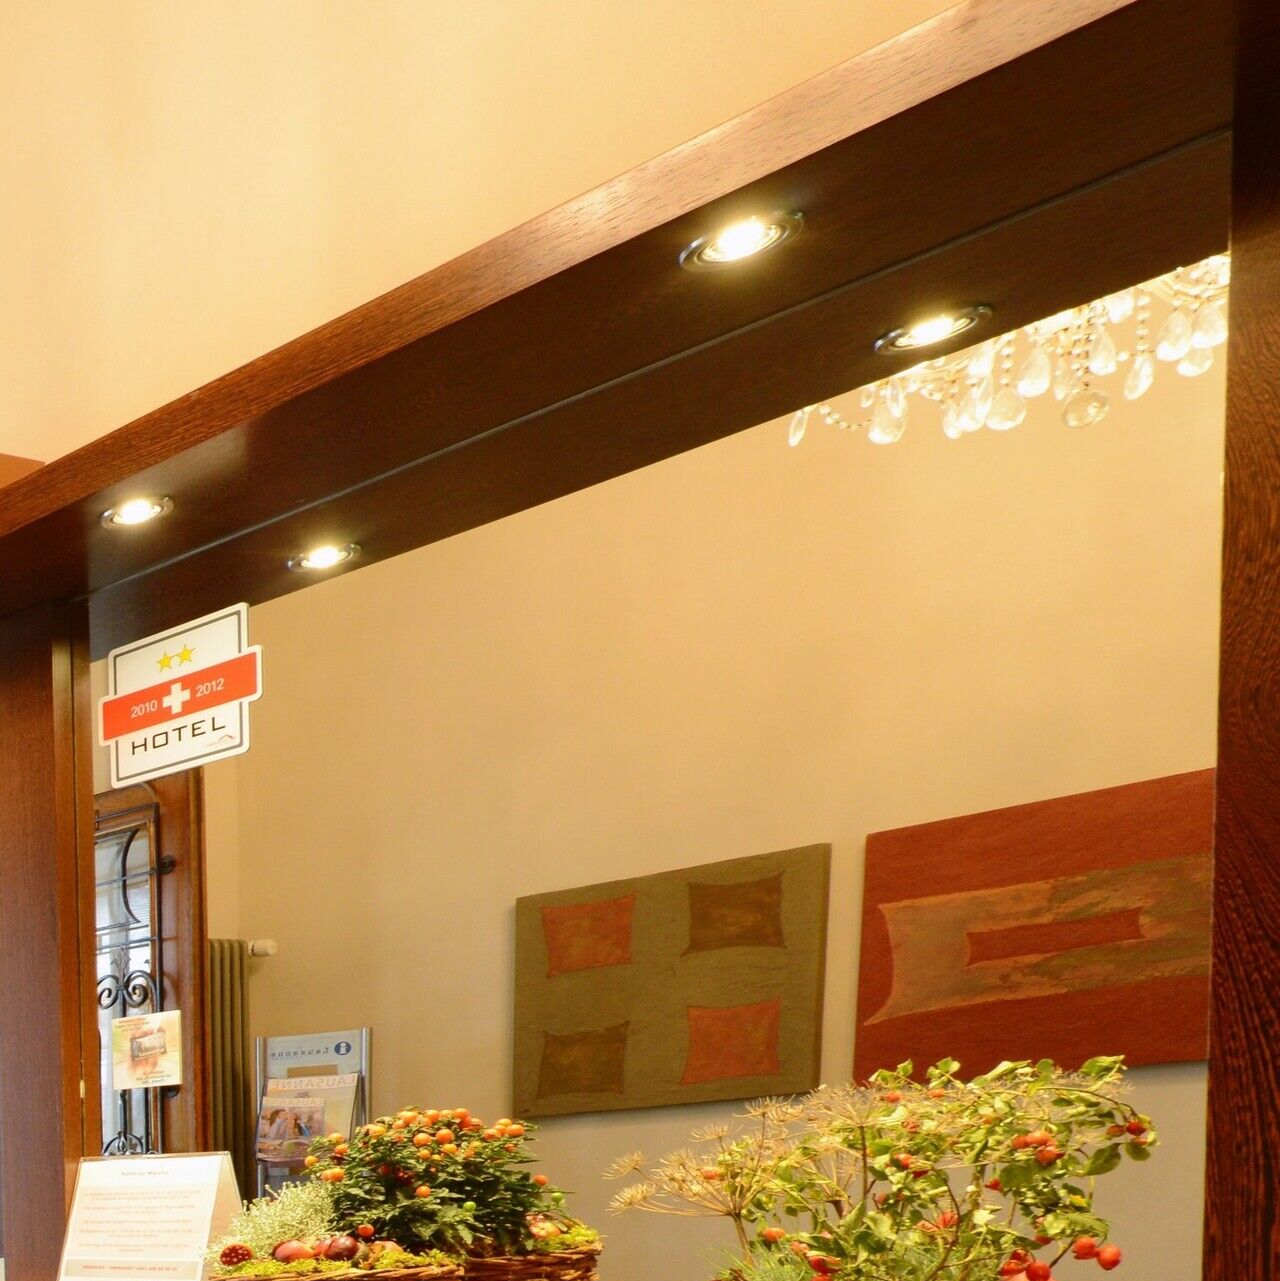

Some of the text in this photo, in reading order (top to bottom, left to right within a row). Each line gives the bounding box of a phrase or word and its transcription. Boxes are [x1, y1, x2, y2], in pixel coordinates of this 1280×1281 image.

[130, 677, 225, 719] 2010 2012
[131, 716, 226, 756] HOTEL
